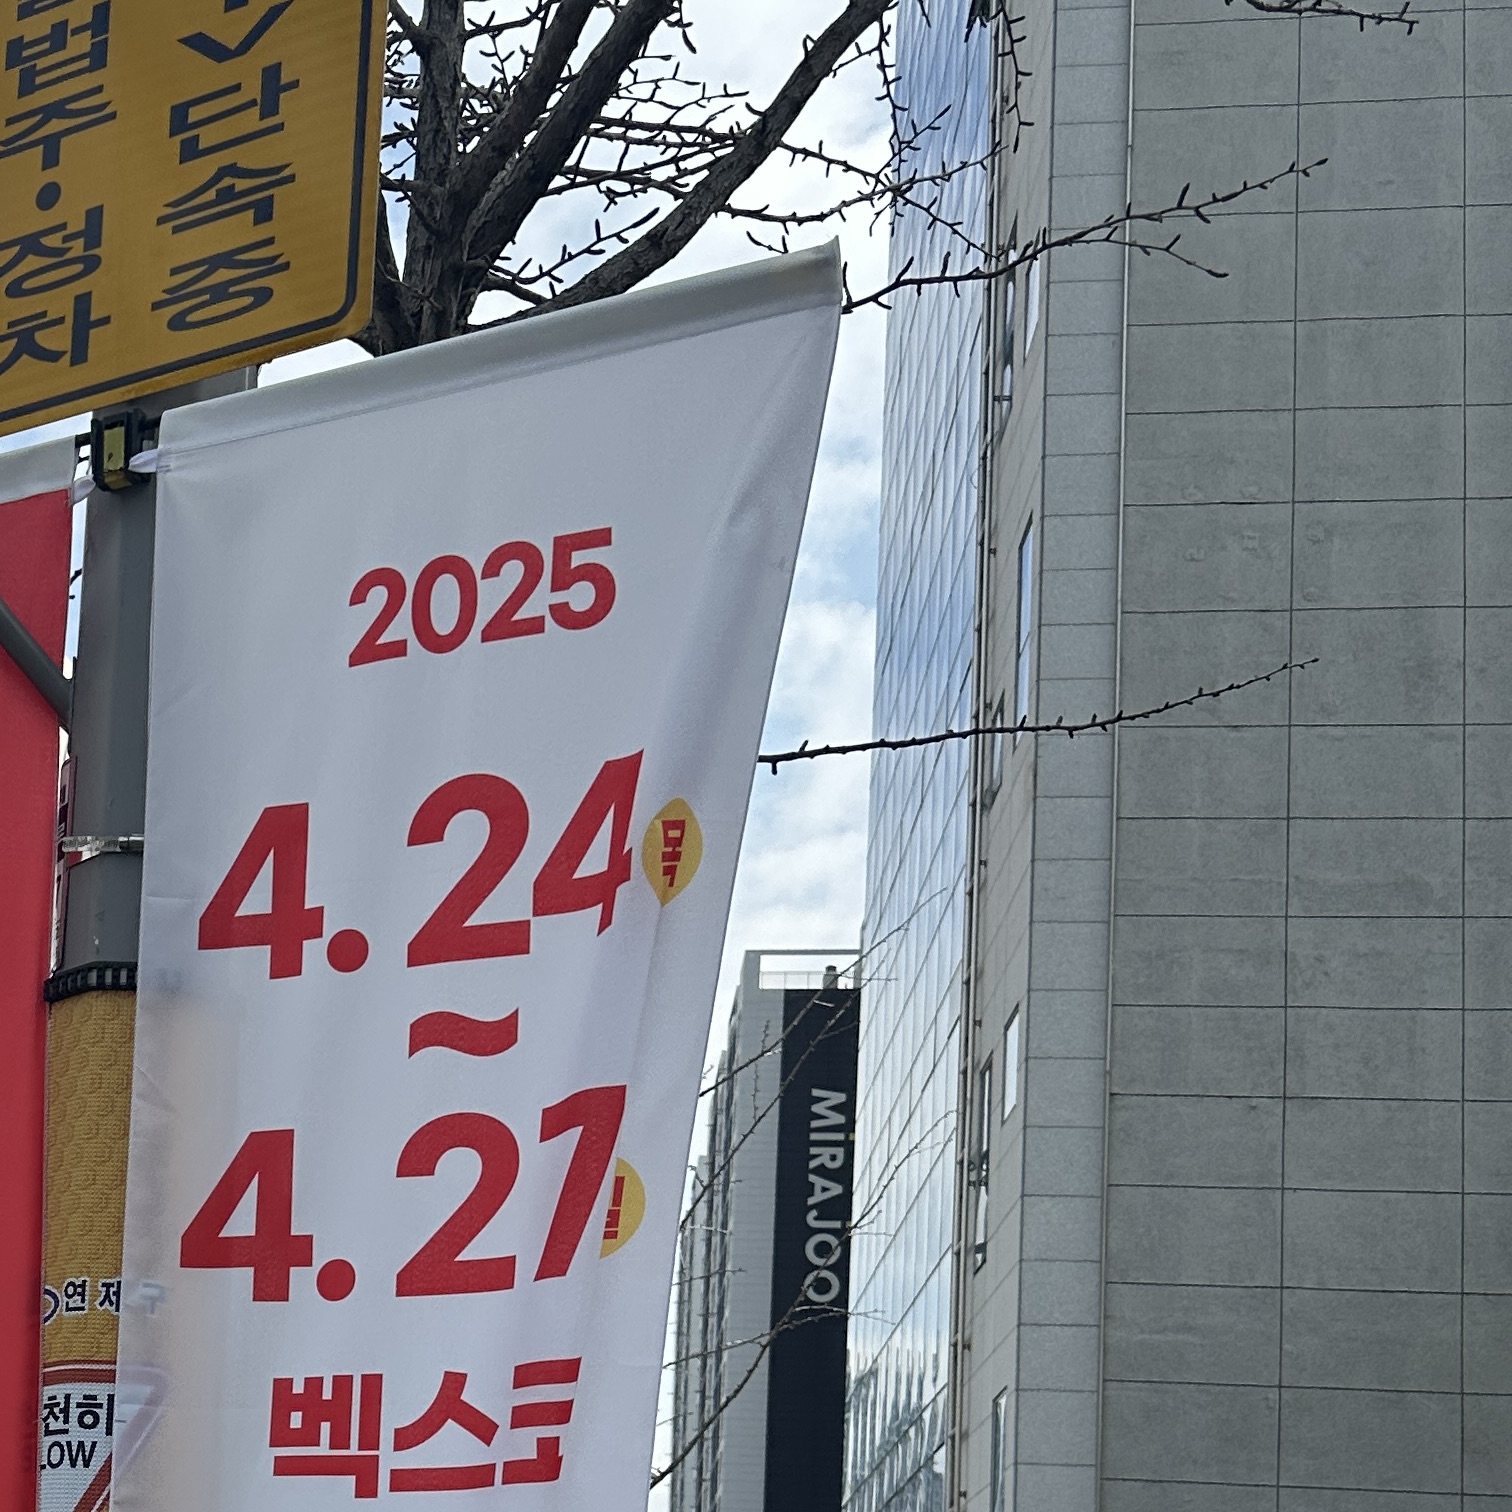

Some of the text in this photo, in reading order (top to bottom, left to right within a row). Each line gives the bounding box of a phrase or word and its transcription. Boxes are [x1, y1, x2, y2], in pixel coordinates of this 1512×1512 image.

[348, 526, 617, 668] 2025
[802, 1087, 848, 1304] MIRAJOO
[40, 1440, 98, 1470] OW
[268, 1356, 583, 1500] 벡스코
